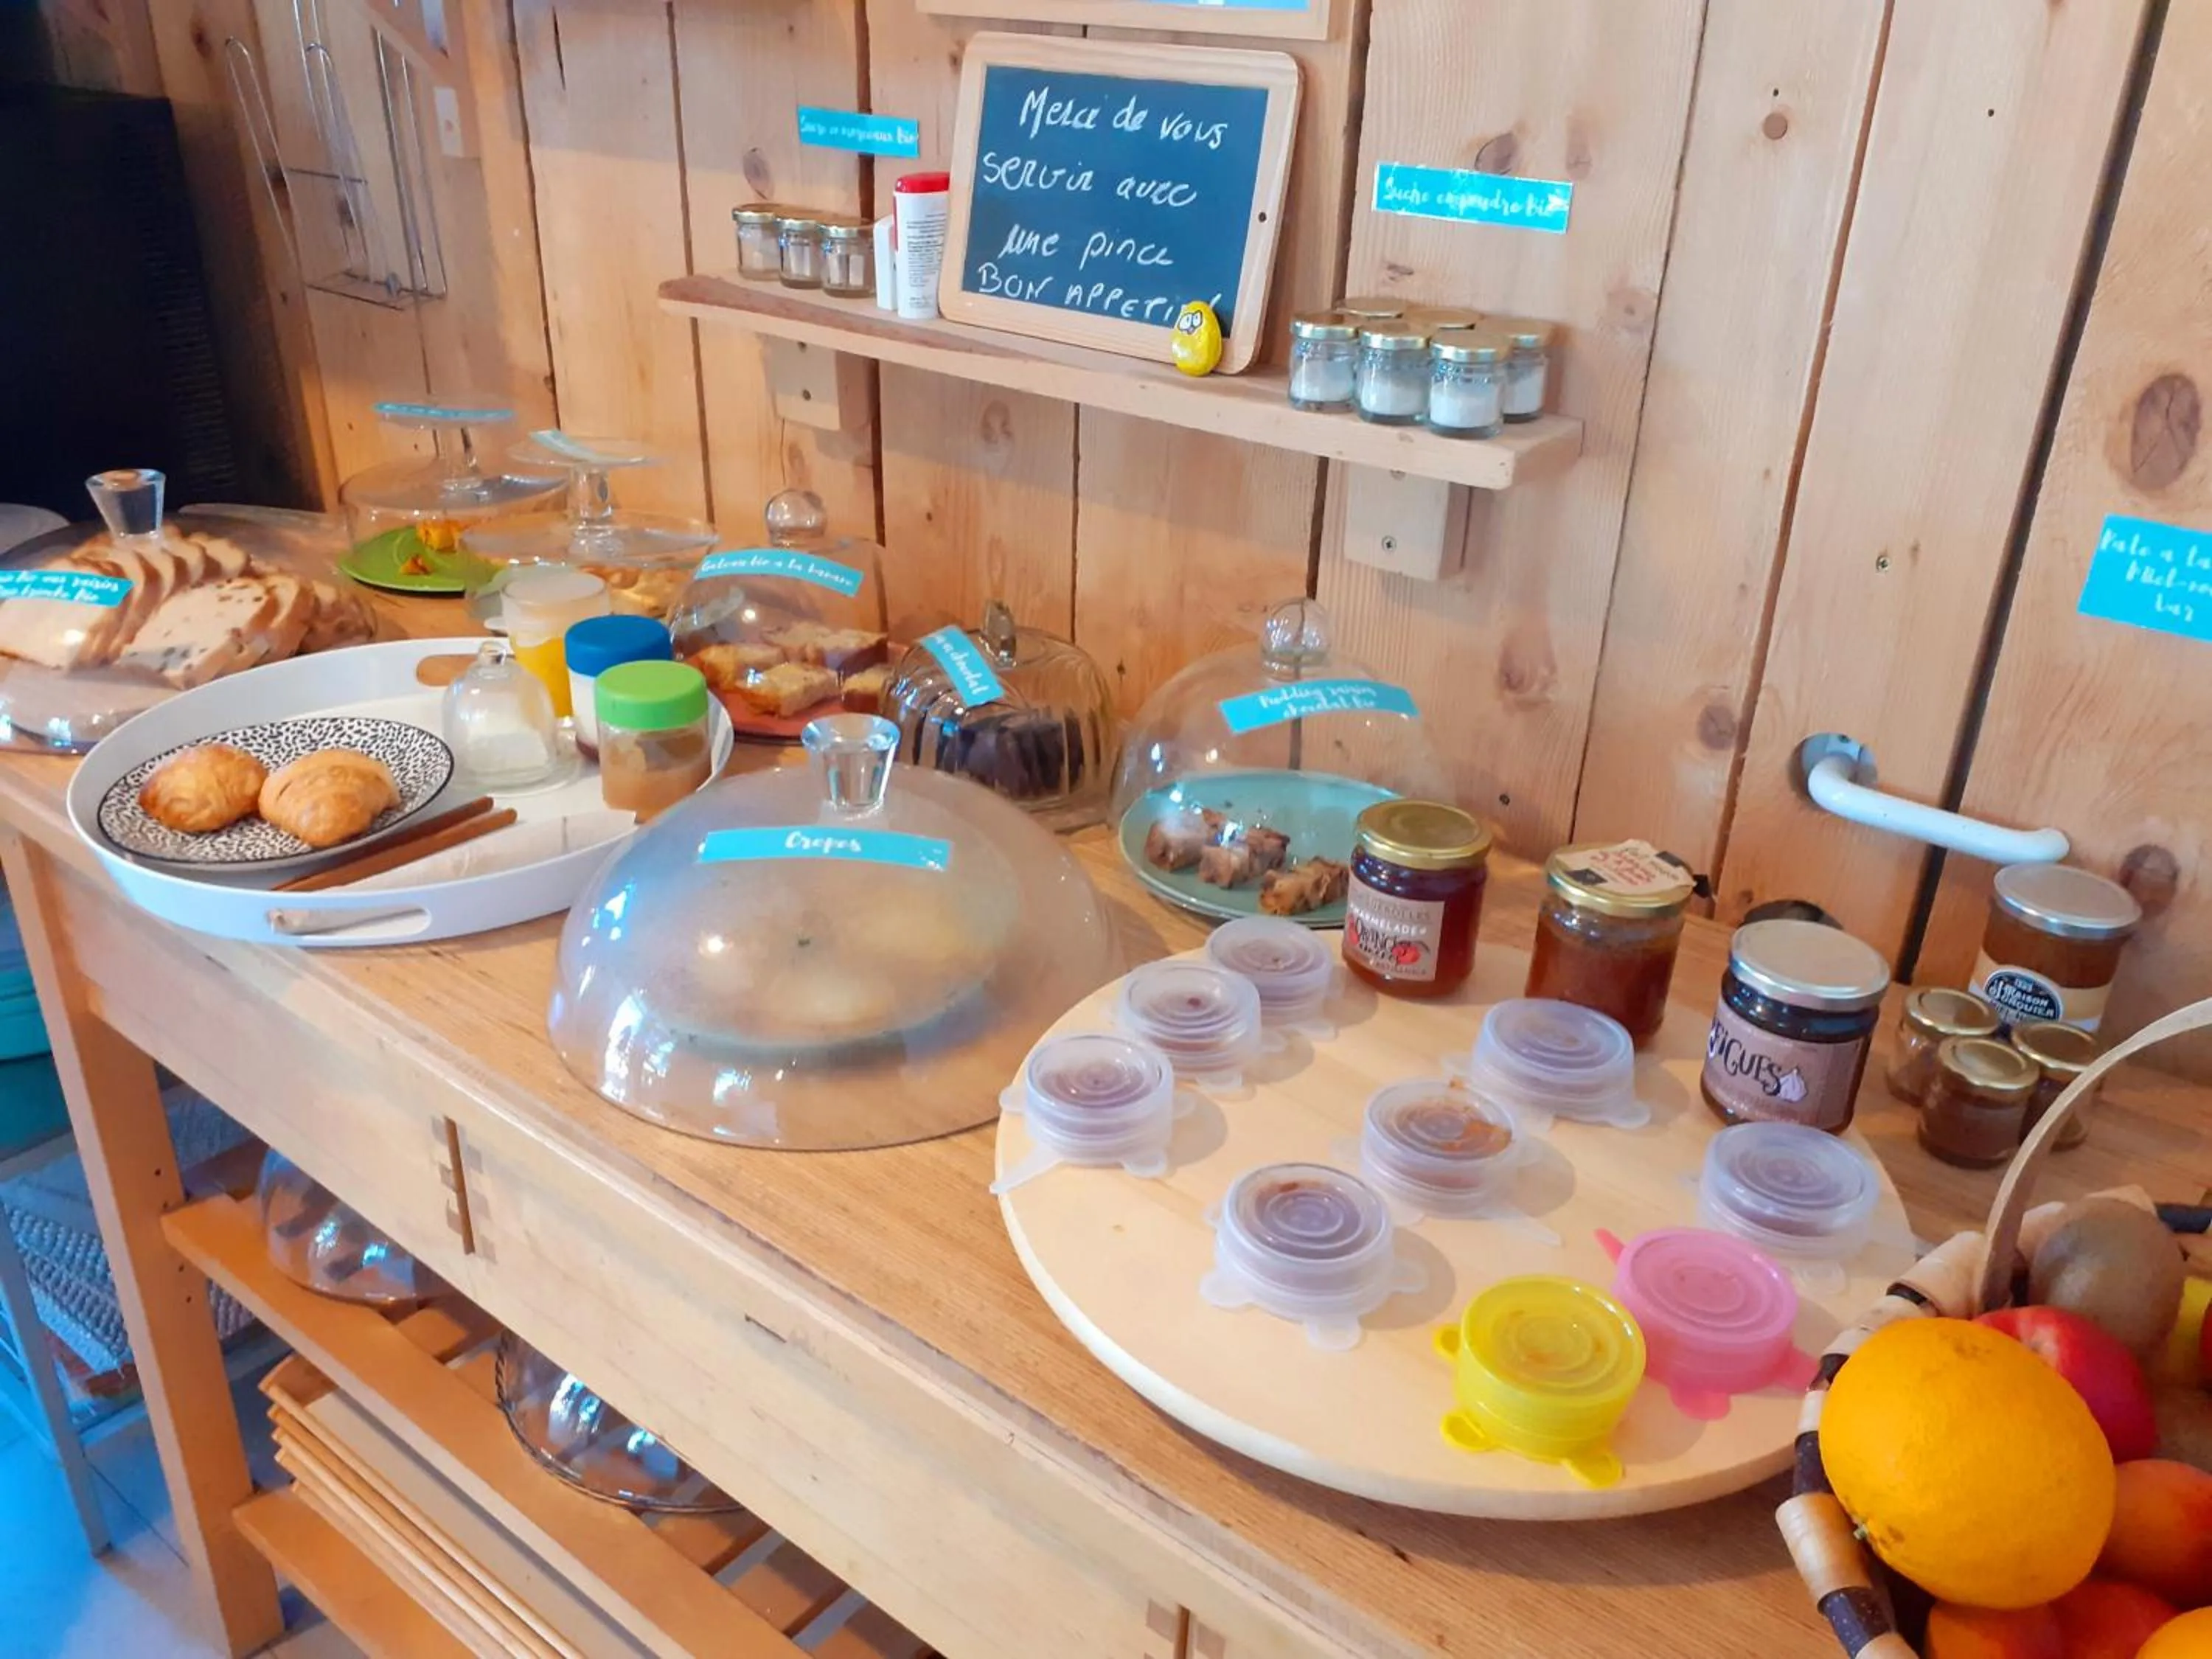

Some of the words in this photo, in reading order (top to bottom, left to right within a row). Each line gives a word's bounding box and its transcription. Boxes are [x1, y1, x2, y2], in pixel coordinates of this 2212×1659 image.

[1112, 95, 1149, 132] de
[1159, 115, 1228, 150] vous
[1116, 177, 1197, 207] avec
[998, 224, 1060, 260] une
[978, 262, 1053, 299] BON
[1064, 282, 1184, 321] APPETI
[1710, 1018, 1782, 1096] FIGUES
